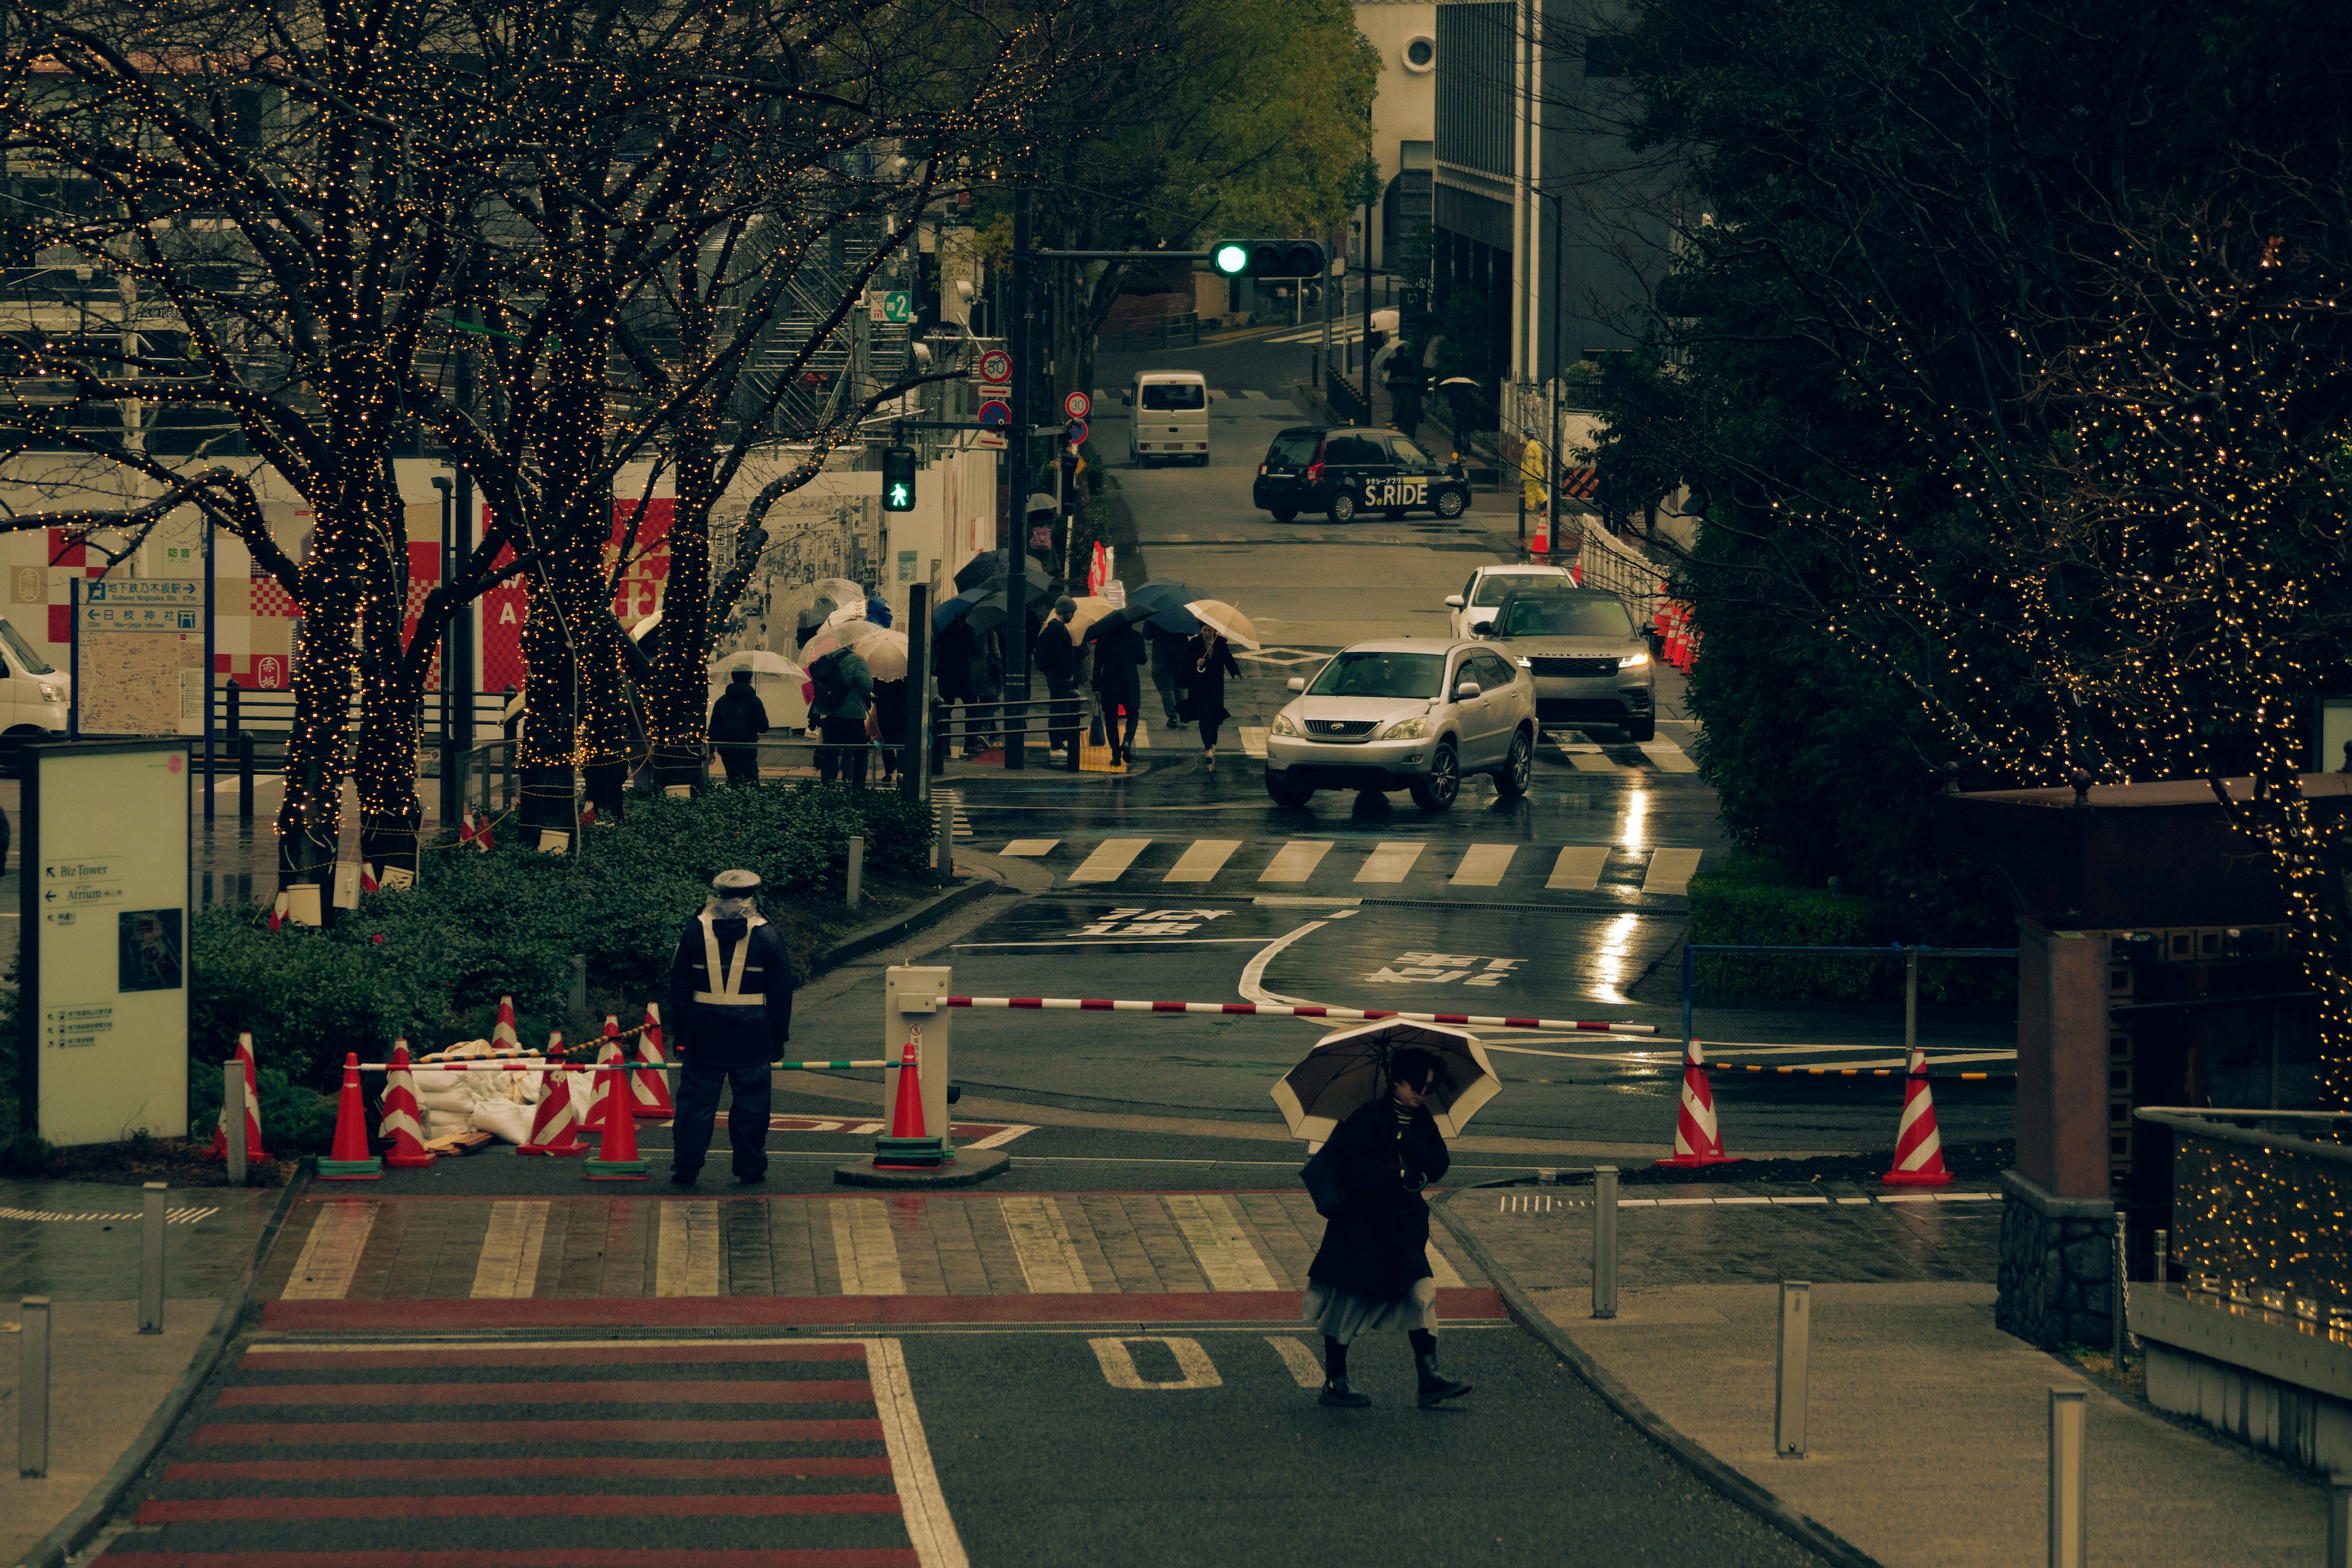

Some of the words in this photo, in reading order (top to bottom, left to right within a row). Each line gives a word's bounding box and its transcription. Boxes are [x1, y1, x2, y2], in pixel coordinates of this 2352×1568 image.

[896, 295, 907, 317] 2
[987, 360, 1005, 374] 30
[1071, 400, 1084, 410] 30
[1365, 477, 1401, 486] タクシーアプリ
[1365, 484, 1428, 507] S.RIDE
[167, 548, 190, 558] 防音
[108, 583, 181, 594] 地下鉄乃木坂駅
[104, 609, 175, 621] 日枝神社
[262, 658, 277, 687] 赤坂
[60, 865, 75, 876] Biz
[78, 864, 107, 876] Tower
[67, 889, 102, 900] Atrium
